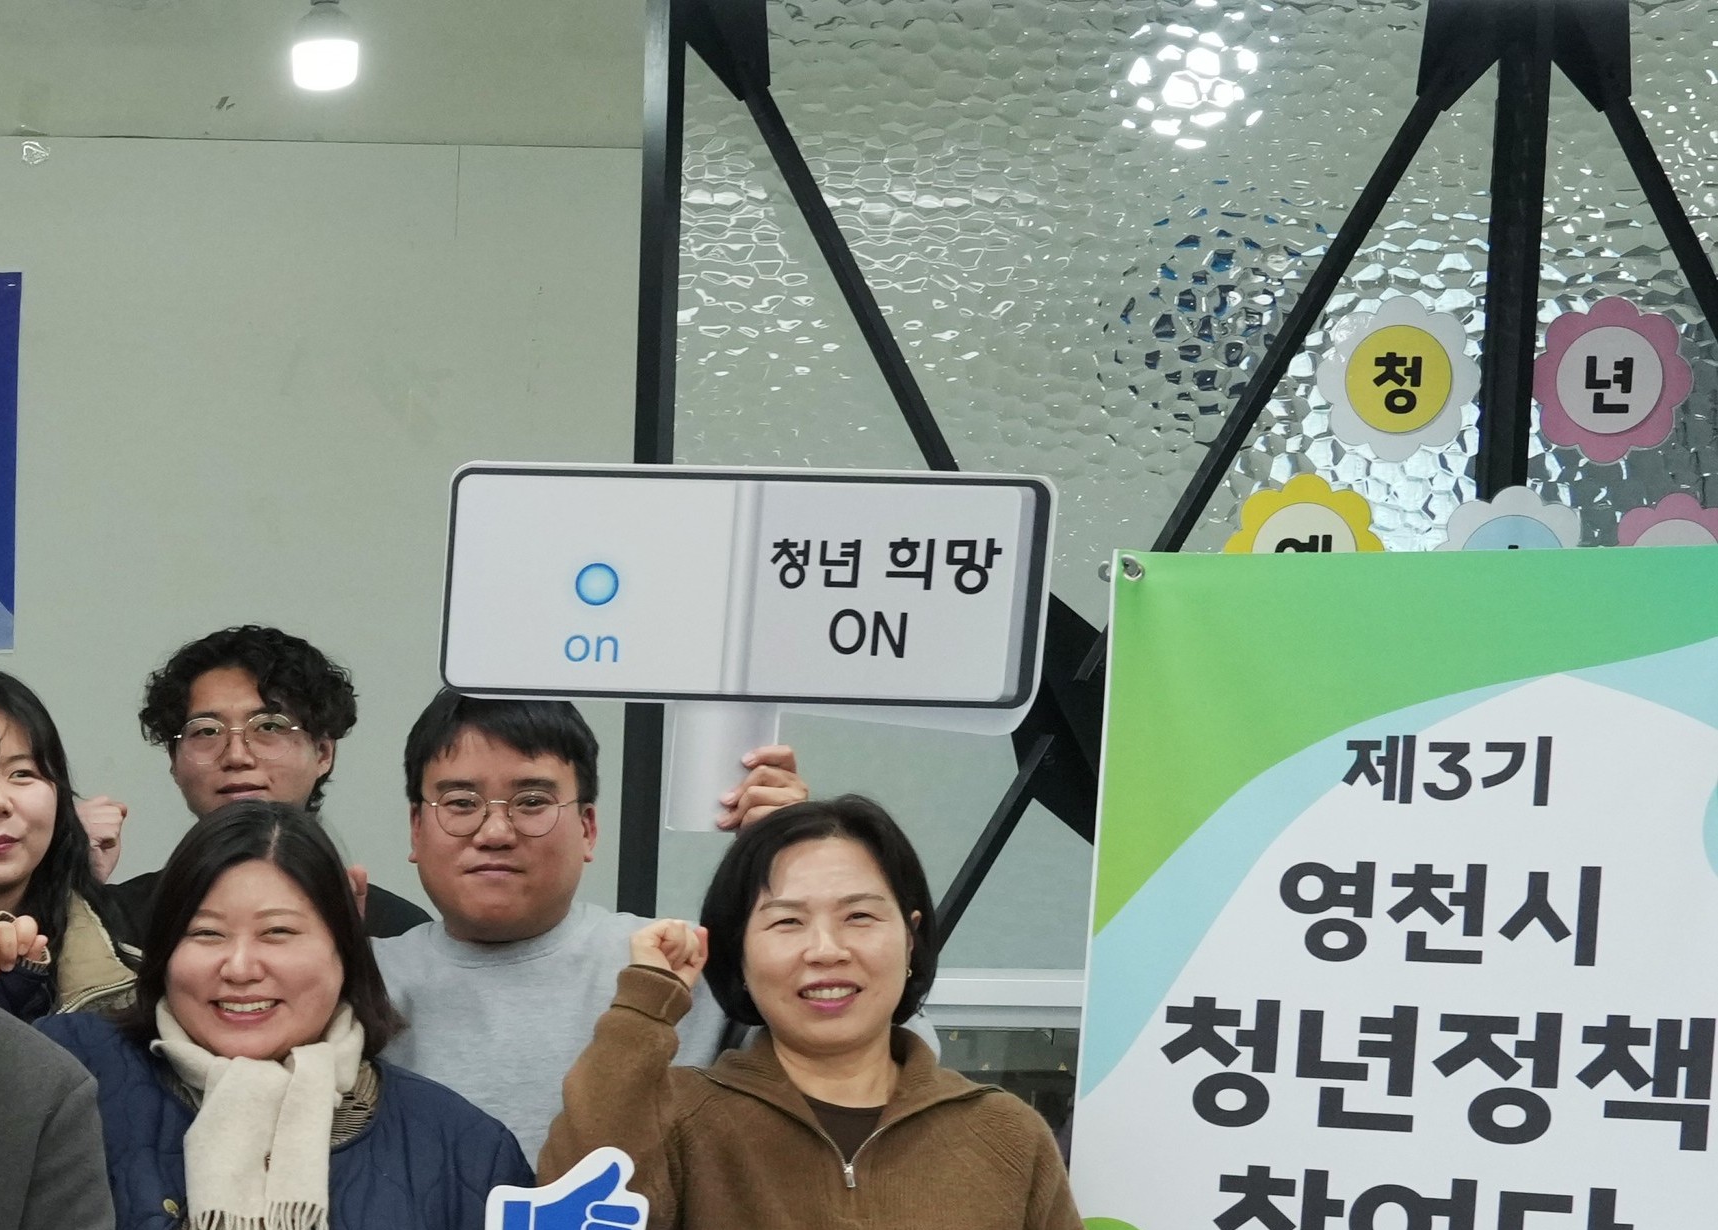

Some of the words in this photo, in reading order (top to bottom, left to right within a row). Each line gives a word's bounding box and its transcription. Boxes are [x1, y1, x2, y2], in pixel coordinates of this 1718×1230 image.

[1373, 352, 1422, 414] 청
[1585, 356, 1633, 413] 년
[771, 539, 861, 589] 청년
[886, 537, 1002, 594] 희망
[565, 635, 618, 662] on
[829, 609, 908, 658] ON
[1342, 735, 1553, 806] 제3기
[1280, 861, 1601, 966] 영천시
[1161, 996, 1716, 1151] 청년정책
